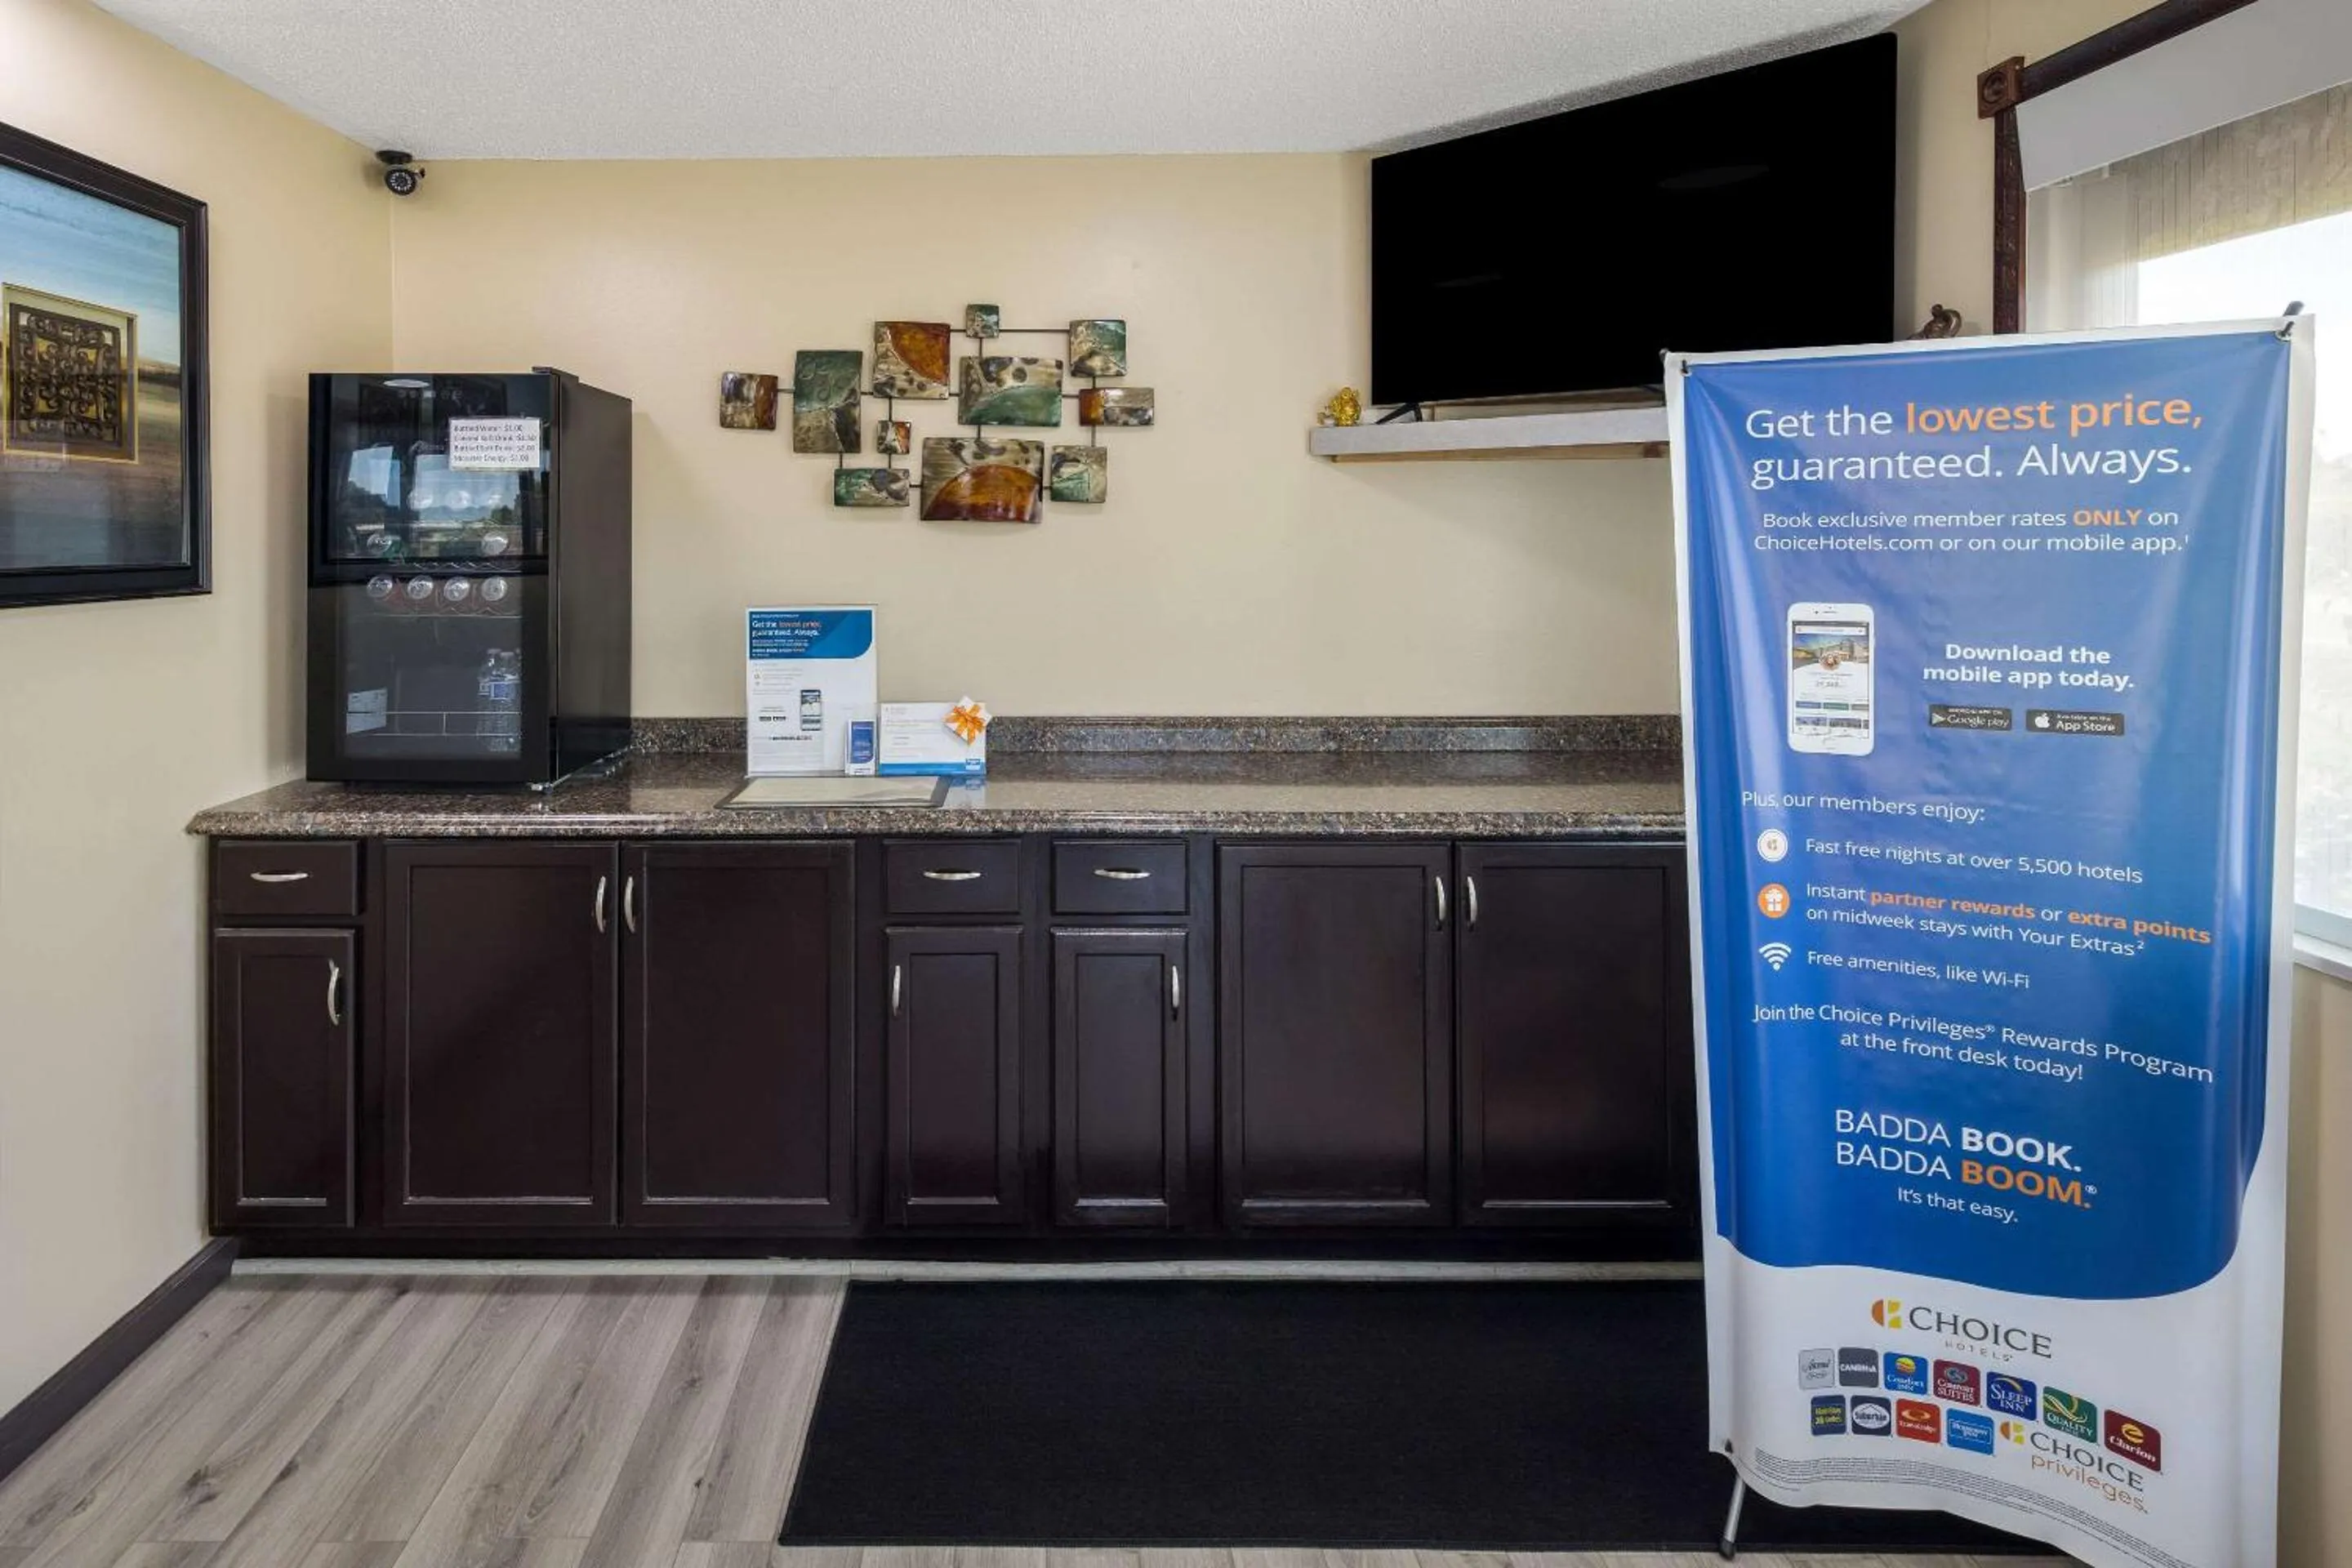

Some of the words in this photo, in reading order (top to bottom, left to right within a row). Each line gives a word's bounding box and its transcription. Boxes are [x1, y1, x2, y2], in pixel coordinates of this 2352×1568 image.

[1745, 409, 1814, 439] Get
[1826, 405, 1893, 436] the
[1907, 399, 2055, 434] lowest
[2069, 394, 2203, 436] price,
[1751, 445, 2002, 490] guaranteed.
[2017, 443, 2191, 483] Always.
[1763, 512, 1811, 528] Book
[1818, 511, 1907, 528] exclusive
[1913, 510, 2002, 528] member
[2011, 510, 2066, 527] rates
[2073, 510, 2142, 527] ONLY
[2148, 511, 2178, 526] on
[1754, 534, 1932, 551] ChoiceHotels.com
[1940, 537, 1962, 550] or
[1968, 537, 1995, 550] on
[2002, 537, 2040, 550] our
[2047, 533, 2124, 550] mobile
[1946, 644, 2062, 664] Download
[2069, 647, 2110, 665] the
[1923, 666, 2001, 684] mobile
[2008, 671, 2051, 689] app
[2059, 670, 2134, 692] today.
[1947, 715, 1986, 728] Google
[1988, 718, 2009, 728] play
[2056, 720, 2082, 732] App
[2083, 721, 2116, 732] Store
[1743, 791, 1779, 808] Plus,
[1784, 795, 1814, 808] our
[1820, 795, 1917, 816] members
[1923, 803, 1985, 824] enjoy:
[1806, 839, 1840, 854] Fast
[1846, 840, 1880, 858] free
[1886, 845, 1941, 865] nights
[1946, 851, 1965, 865] at
[1970, 855, 2011, 870] over
[2019, 857, 2072, 877] 5,500
[2078, 862, 2143, 884] hotels
[1806, 884, 1865, 902] Instant
[1870, 889, 1944, 911] partner
[1951, 895, 2035, 919] rewards
[2041, 907, 2062, 920] or
[2068, 911, 2126, 929] extra
[2133, 917, 2212, 944] points
[1806, 909, 1828, 920] on
[1833, 908, 1914, 929] midweek
[1920, 918, 1967, 938] stays
[1972, 921, 2013, 940] with
[2019, 928, 2064, 946] Your
[1808, 951, 1842, 967] Free
[1847, 954, 1940, 979] amenities,
[1946, 964, 1977, 982] like
[1983, 969, 2029, 989] Wi-Fi
[1753, 1004, 1785, 1024] Join
[1788, 1004, 1815, 1020] the
[1819, 1004, 1883, 1026] Choice
[2002, 1027, 2097, 1057] Rewards
[2105, 1043, 2213, 1084] Program
[1841, 1032, 1859, 1046] at
[1864, 1032, 1897, 1051] the
[1902, 1037, 1953, 1059] front
[1958, 1045, 2008, 1068] desk
[2014, 1055, 2083, 1082] today!
[1836, 1109, 1951, 1147] BADDA
[1962, 1127, 2082, 1172] BOOK.
[1837, 1143, 1951, 1180] BADDA
[1927, 1192, 1965, 1212] that
[1970, 1200, 2018, 1223] easy.
[1909, 1307, 2051, 1359] CHOICE
[1937, 1388, 1975, 1402] SUITES
[1991, 1383, 2032, 1404] SLEEP
[2000, 1401, 2025, 1412] INN
[2047, 1412, 2092, 1437] QUALITY
[2030, 1432, 2144, 1492] CHOICE
[2109, 1436, 2156, 1463] Clarion
